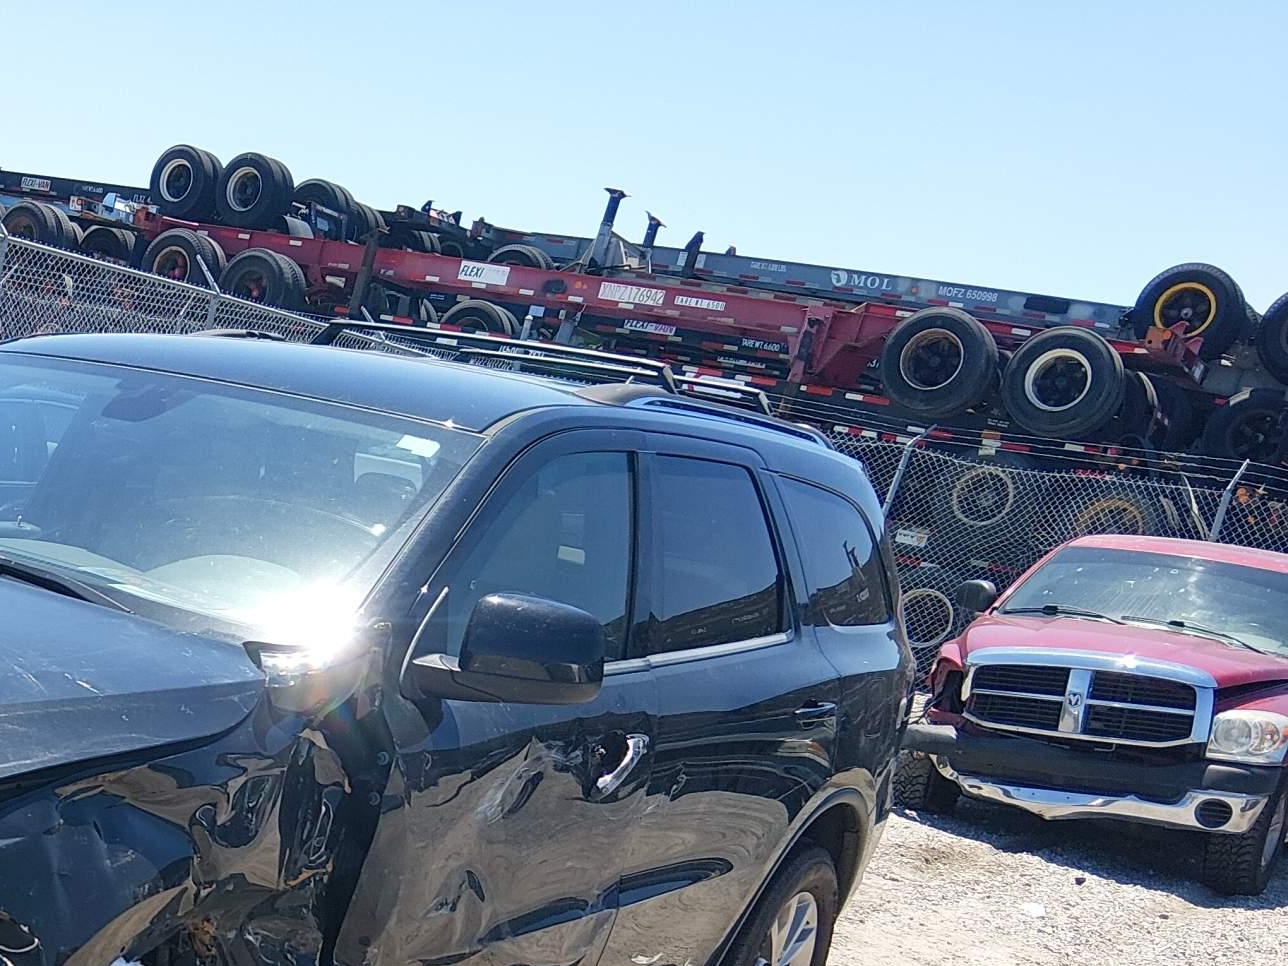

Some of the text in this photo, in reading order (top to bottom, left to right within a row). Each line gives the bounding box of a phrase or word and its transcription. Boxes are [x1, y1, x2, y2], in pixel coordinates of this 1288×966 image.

[460, 264, 485, 278] FLEXI
[850, 273, 892, 290] MOL
[938, 286, 999, 302] MOFZ 650998
